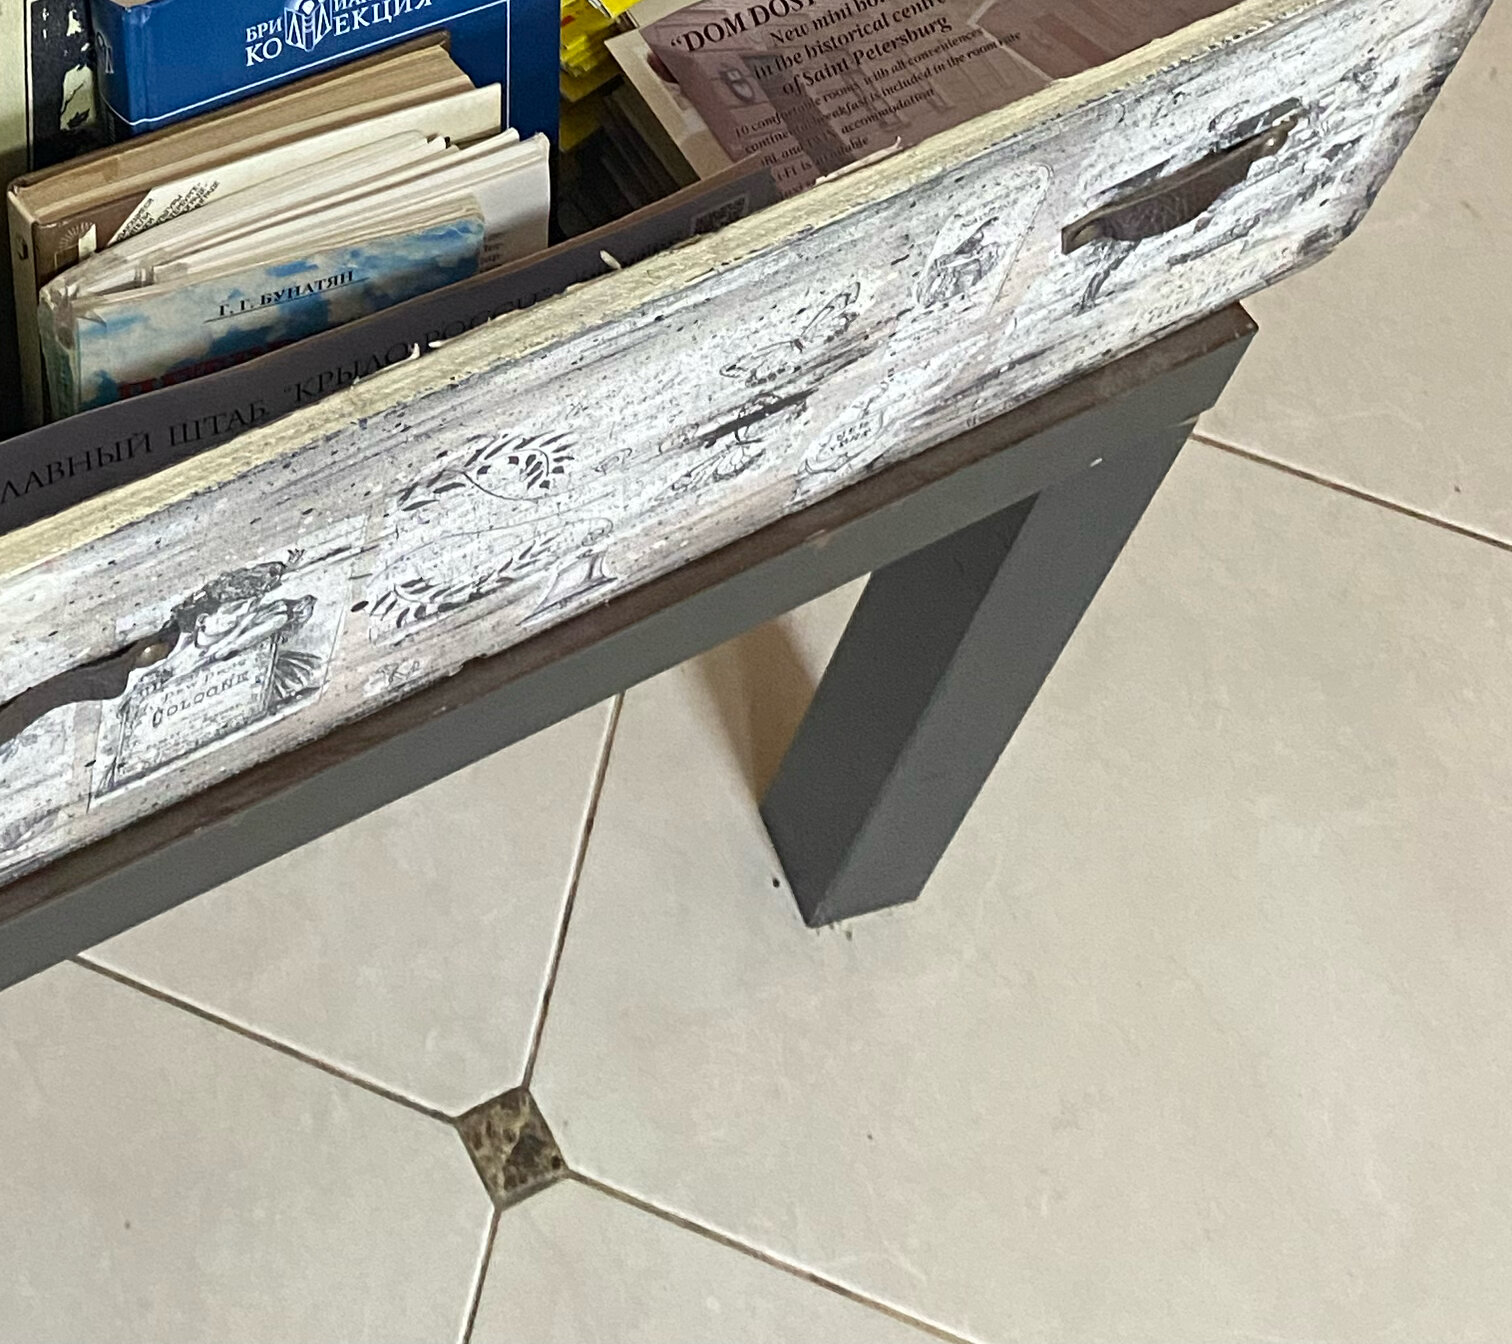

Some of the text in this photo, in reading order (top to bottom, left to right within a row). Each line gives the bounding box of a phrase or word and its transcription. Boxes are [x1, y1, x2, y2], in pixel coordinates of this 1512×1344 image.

[668, 10, 750, 61] “DOM
[751, 58, 775, 81] in
[771, 45, 806, 74] the
[801, 10, 892, 62] historical
[768, 17, 812, 48] New
[808, 0, 855, 32] mini
[778, 12, 953, 101] of Saint Petersburg
[214, 299, 237, 321] Г.
[256, 264, 359, 310] БУНАТЯН
